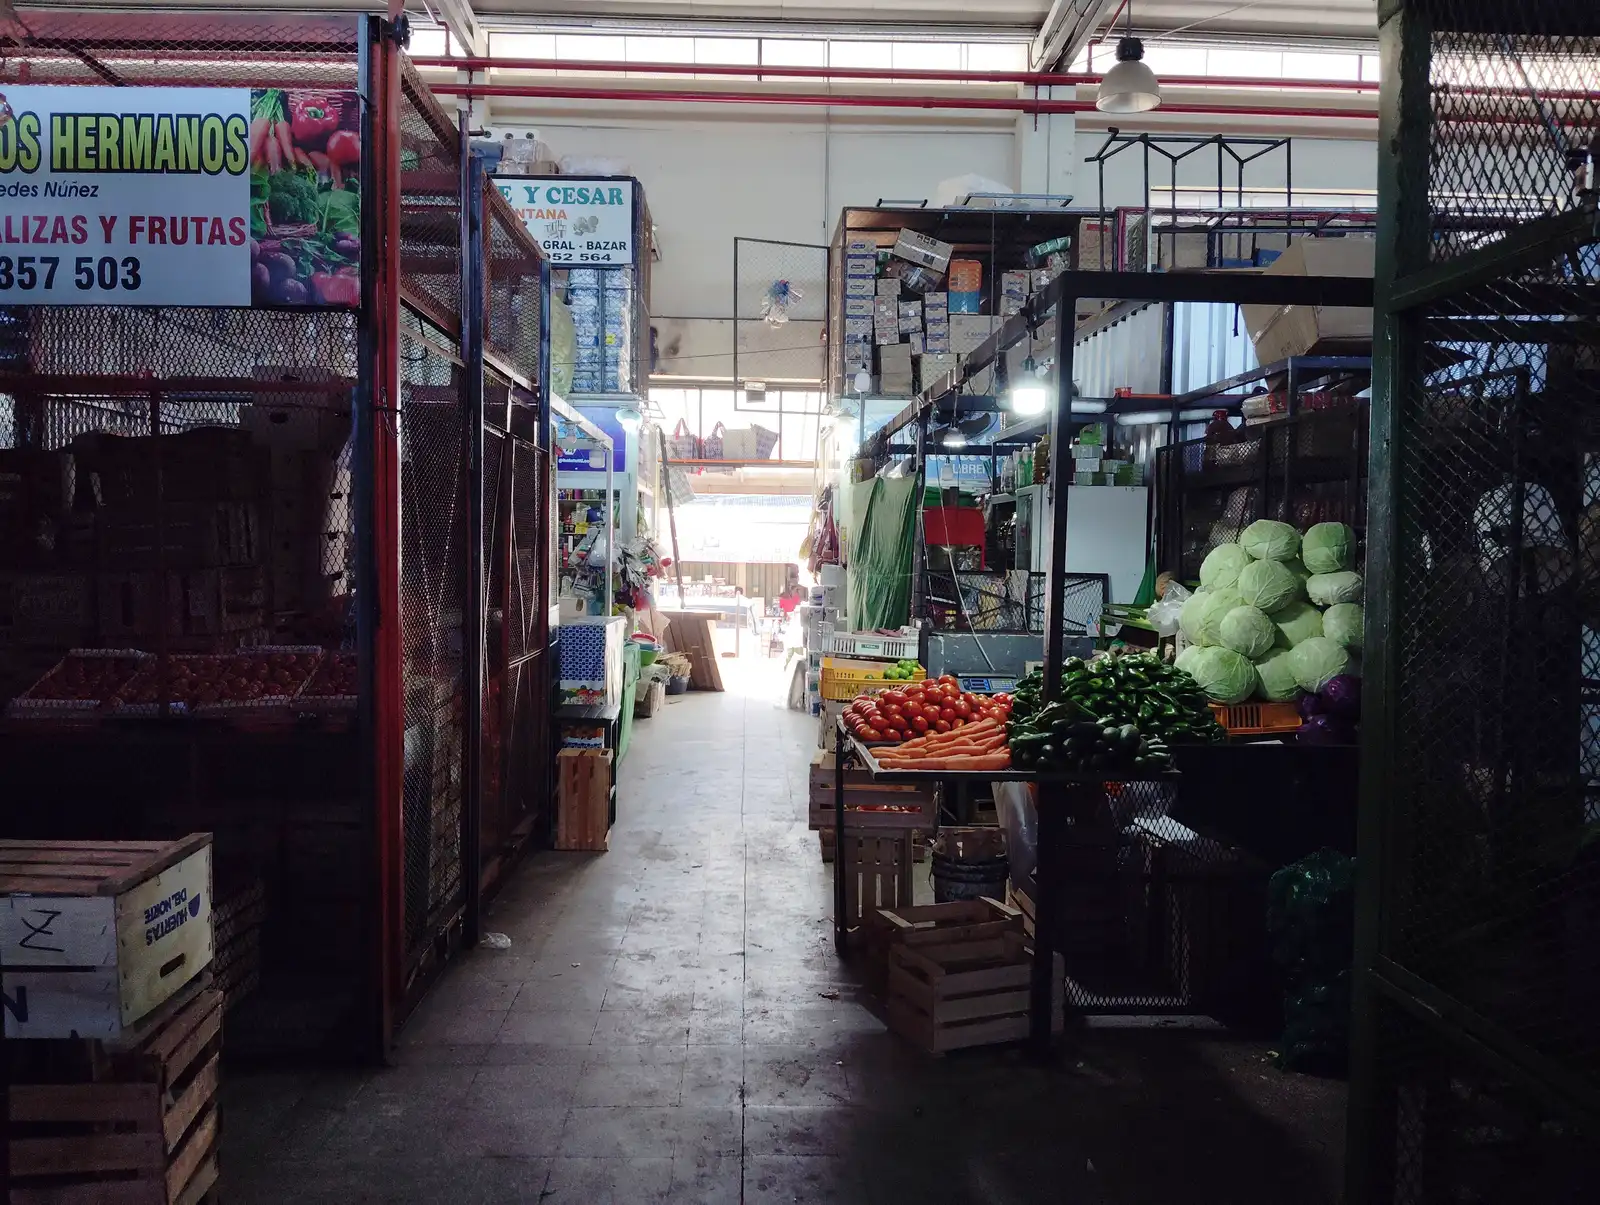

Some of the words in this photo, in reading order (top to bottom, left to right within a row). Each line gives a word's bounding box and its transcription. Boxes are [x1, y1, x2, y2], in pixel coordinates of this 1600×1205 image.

[50, 112, 250, 175] HERMANOS
[43, 179, 100, 198] Núñez
[523, 186, 541, 204] Y
[546, 187, 624, 205] CESAR
[98, 215, 118, 245] Y
[129, 215, 247, 246] FRUTAS
[543, 240, 575, 250] GRAL
[587, 240, 627, 250] BAZAR
[580, 253, 612, 262] 564
[74, 256, 142, 291] 503
[171, 887, 188, 908] DEL
[145, 907, 189, 947] HUERTAS
